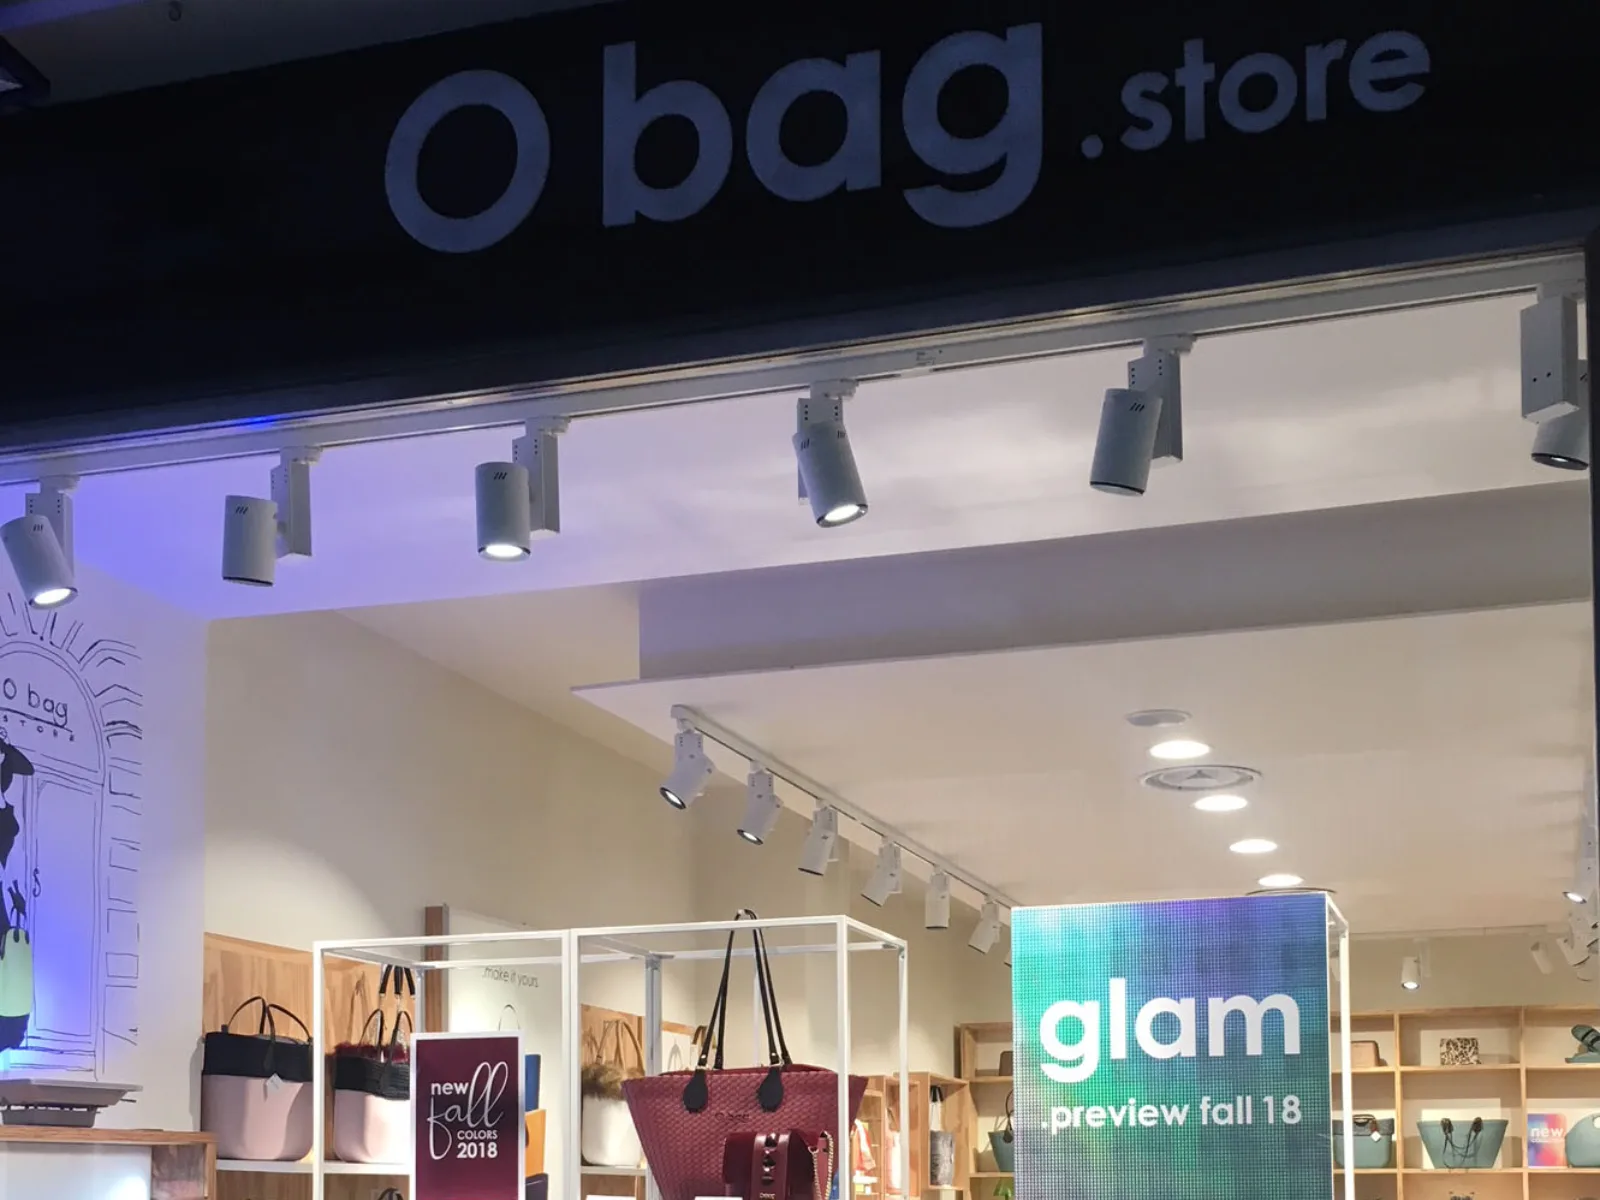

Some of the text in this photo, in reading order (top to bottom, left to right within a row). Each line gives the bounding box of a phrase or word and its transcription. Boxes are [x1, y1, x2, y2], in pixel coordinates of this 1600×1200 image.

[385, 69, 550, 253] O
[603, 22, 1042, 228] bag
[3, 678, 68, 728] O bag
[1040, 977, 1301, 1083] glam
[431, 1082, 469, 1095] new
[427, 1061, 508, 1160] fall
[1041, 1095, 1301, 1136] .preview fall 18
[457, 1130, 498, 1140] COLORS
[457, 1142, 498, 1159] 2018
[1530, 1127, 1564, 1138] new
